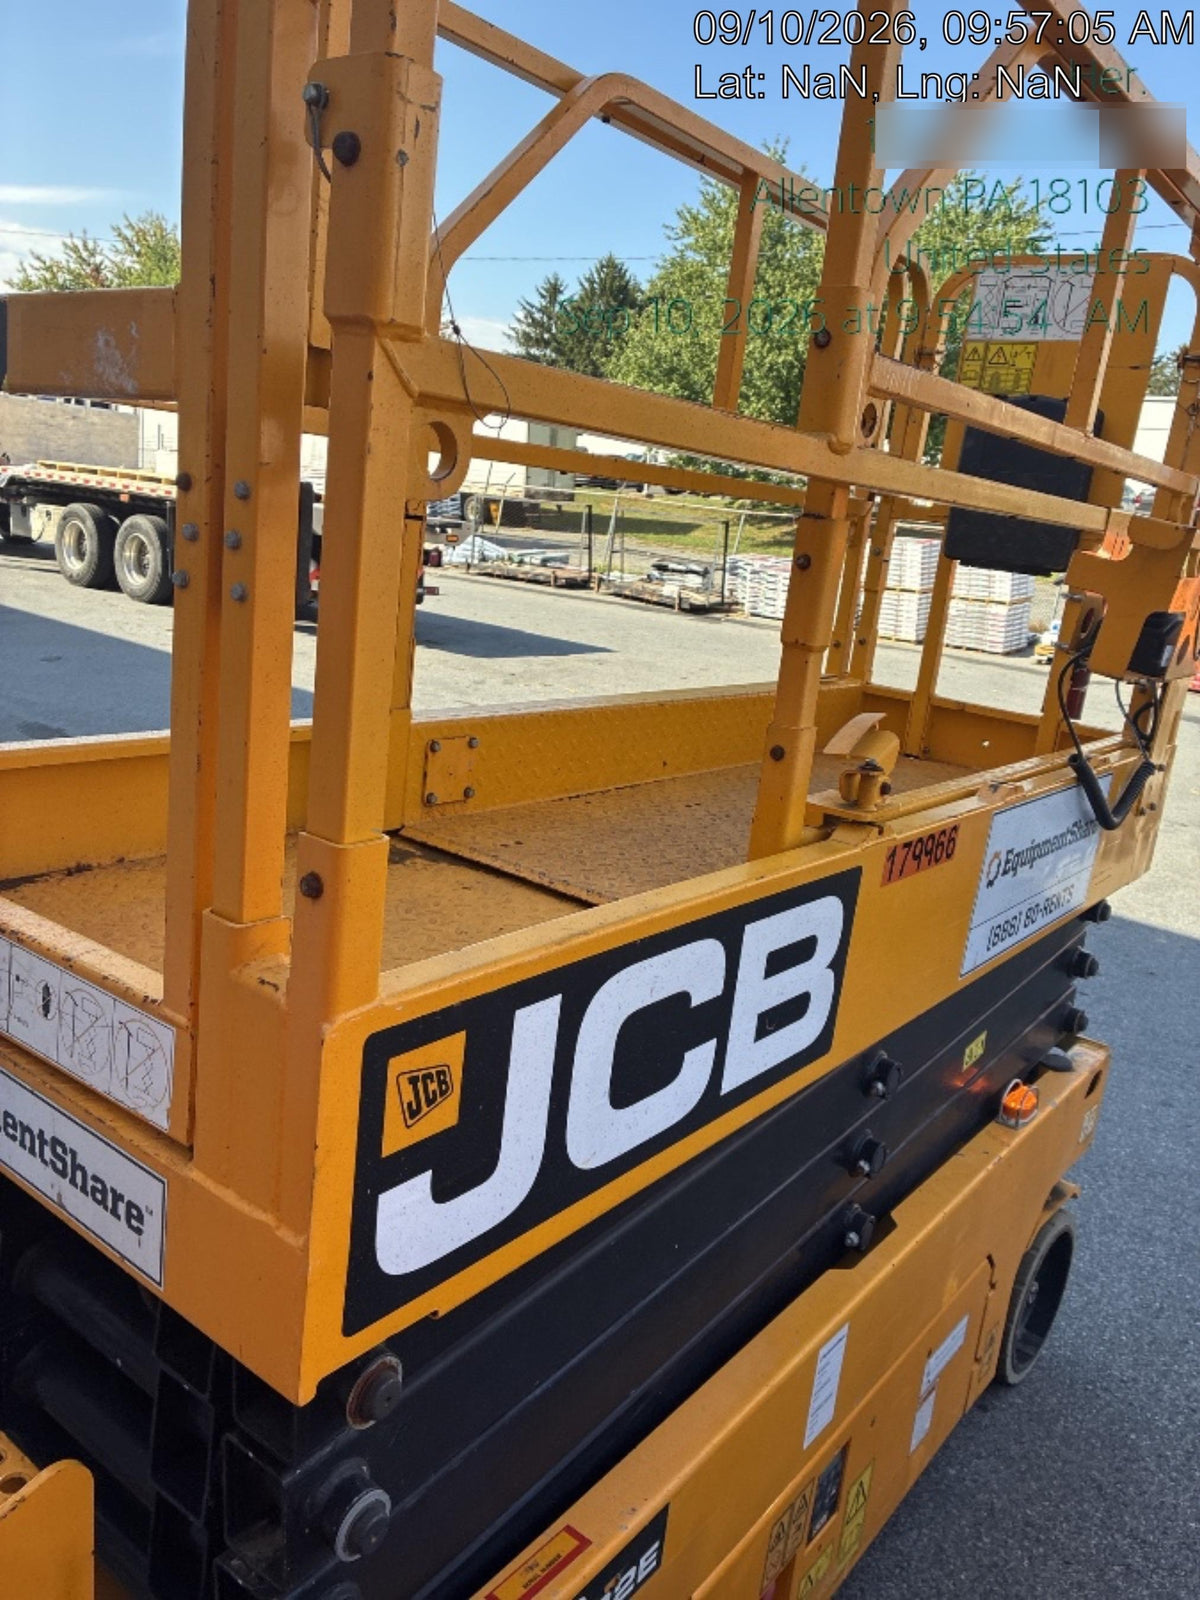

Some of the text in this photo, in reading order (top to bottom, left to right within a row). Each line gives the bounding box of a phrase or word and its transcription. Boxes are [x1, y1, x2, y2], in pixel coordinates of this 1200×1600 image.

[886, 824, 959, 882] 179966
[376, 895, 844, 1276] JCB
[405, 1064, 453, 1121] JCB
[0, 1109, 145, 1237] entShare
